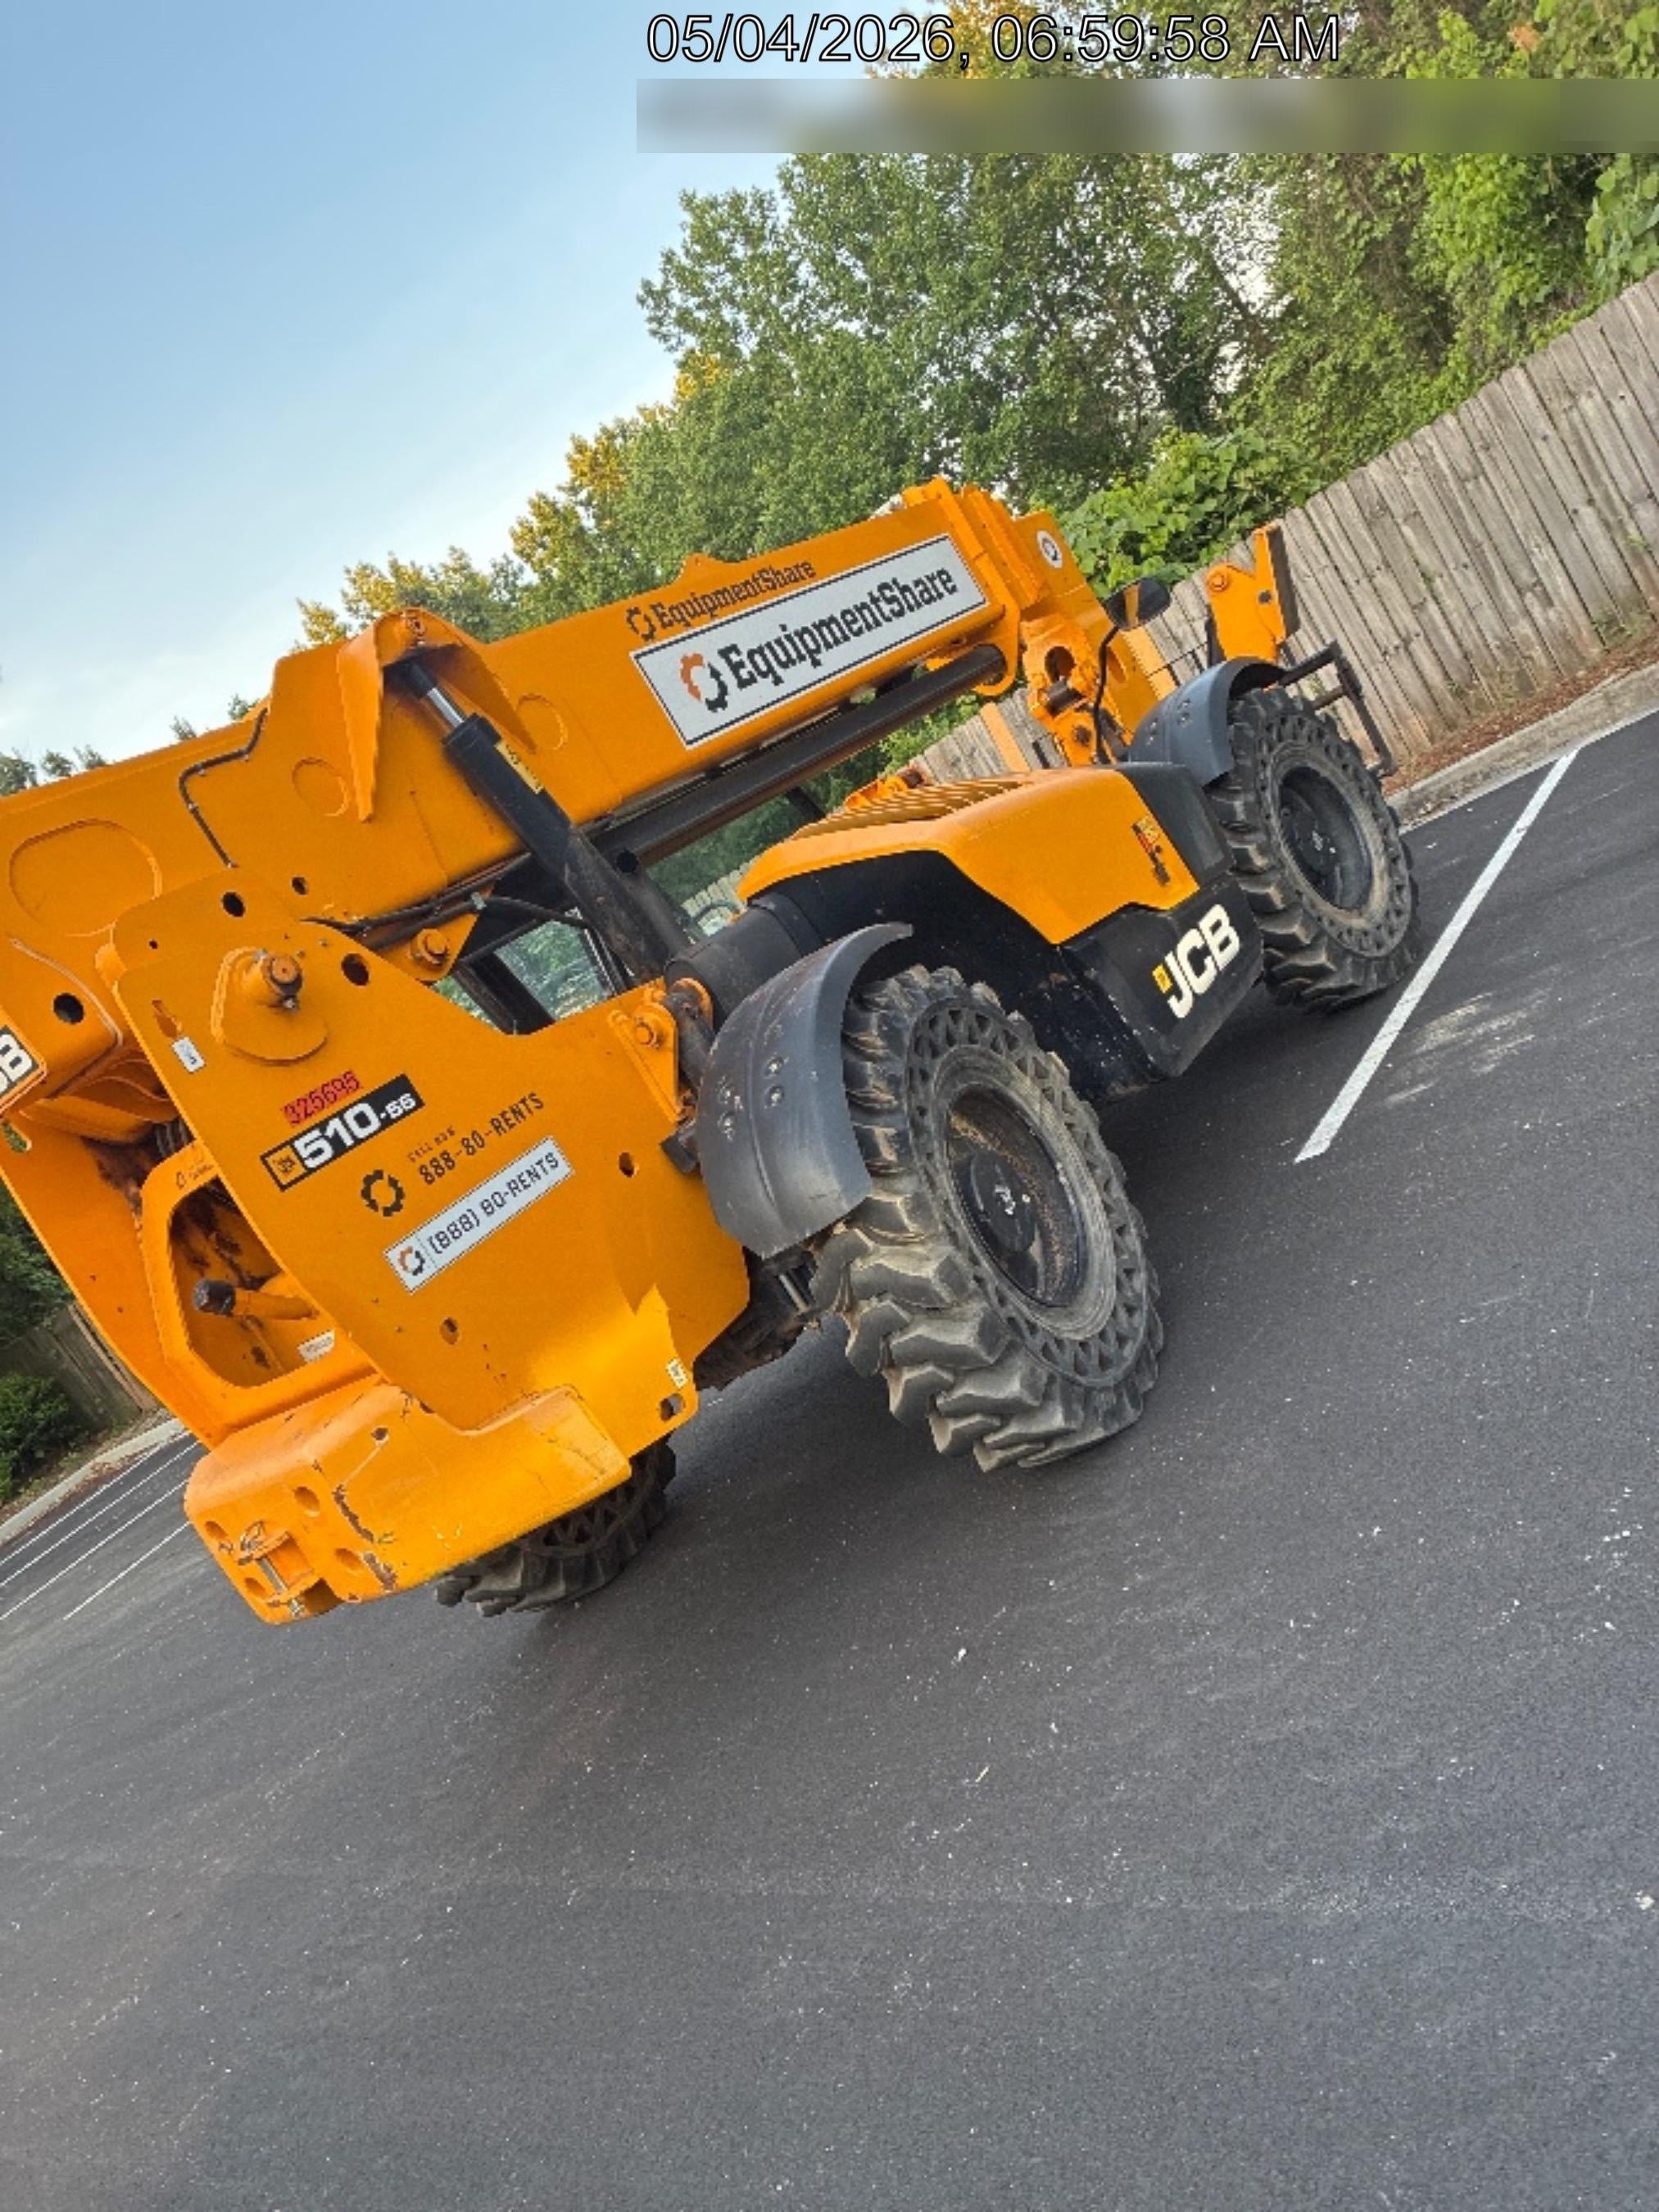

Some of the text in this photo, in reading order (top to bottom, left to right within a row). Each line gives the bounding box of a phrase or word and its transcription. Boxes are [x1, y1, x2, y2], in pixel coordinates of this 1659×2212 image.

[655, 560, 817, 630] EquipmentShare
[718, 566, 959, 690] EquipmentShare
[1164, 904, 1240, 1018] JCB
[419, 1092, 544, 1185] 888-80-RENTS
[428, 1208, 481, 1254] (888)
